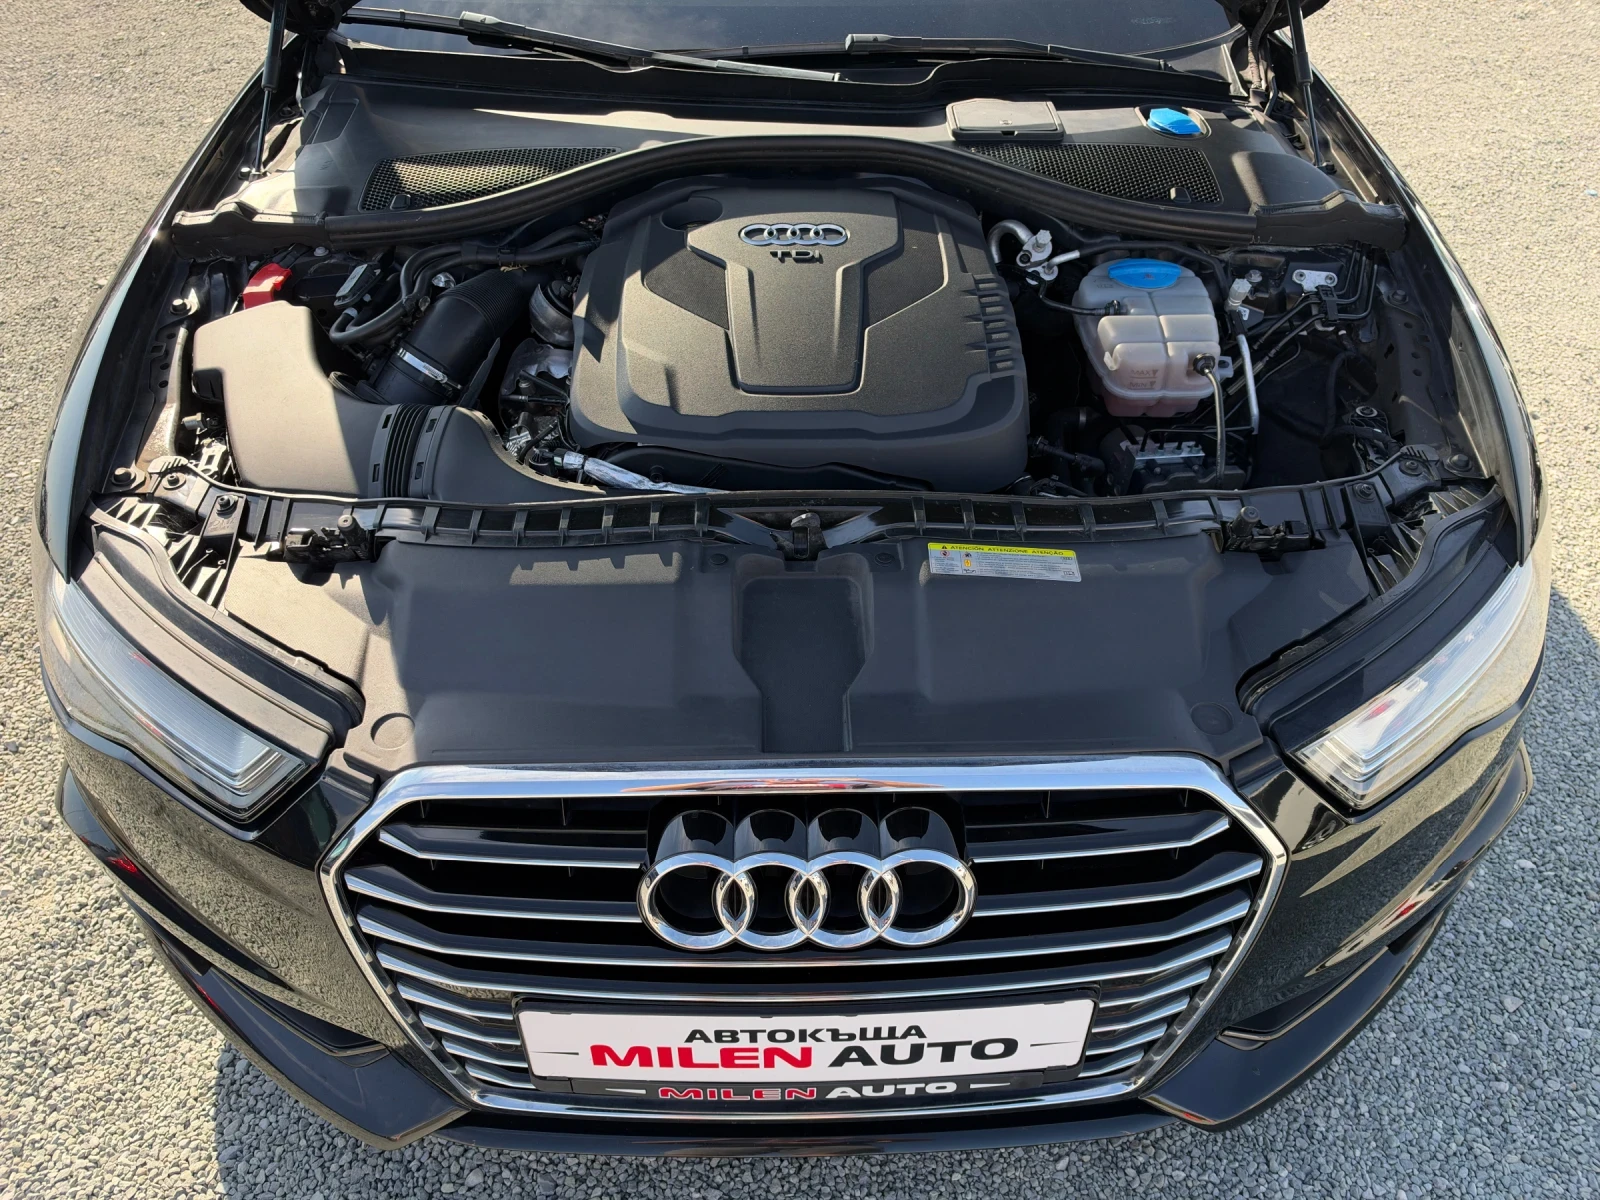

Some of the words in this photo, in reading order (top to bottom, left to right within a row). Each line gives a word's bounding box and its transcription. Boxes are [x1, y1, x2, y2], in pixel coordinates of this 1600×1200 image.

[769, 249, 820, 260] TDI
[590, 1044, 812, 1069] MILEN
[828, 1037, 1019, 1068] AUTO
[658, 1086, 816, 1101] MILEN
[825, 1081, 957, 1099] AUTO
